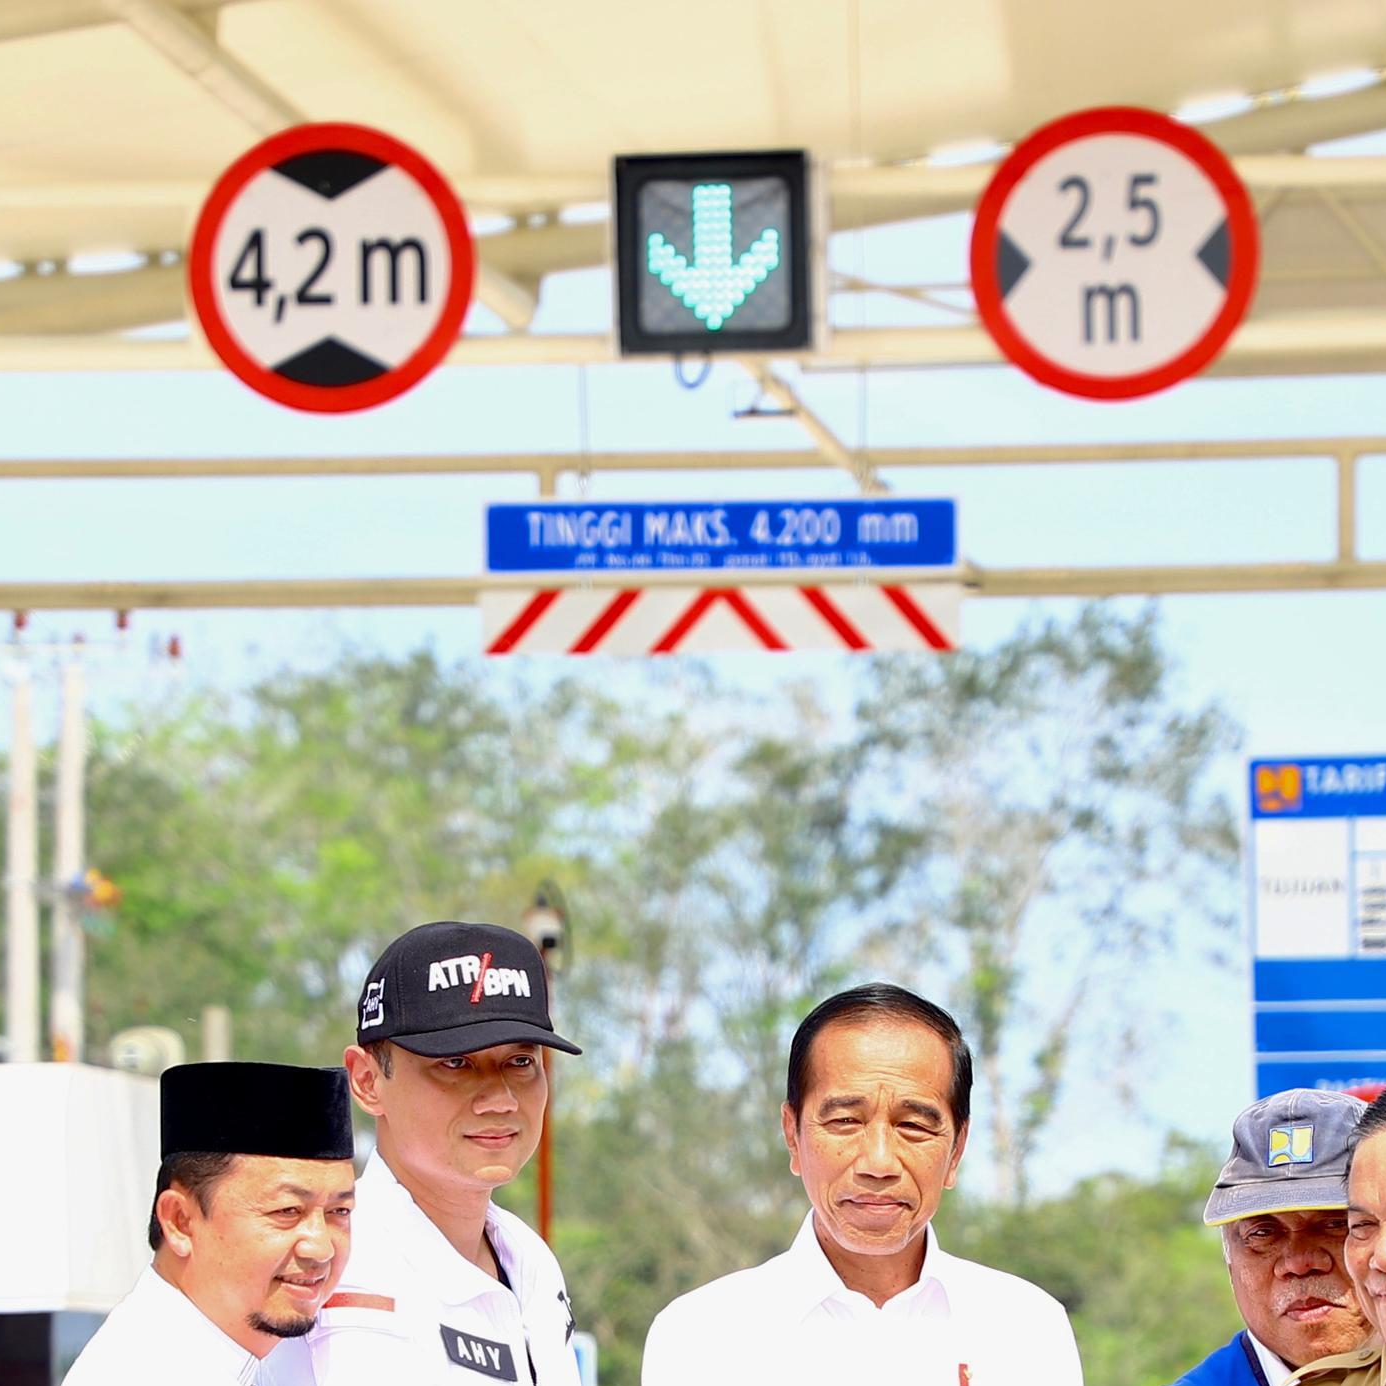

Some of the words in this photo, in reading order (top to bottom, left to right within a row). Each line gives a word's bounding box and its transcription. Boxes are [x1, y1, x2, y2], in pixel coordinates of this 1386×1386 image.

[1058, 174, 1161, 262] 2,5
[228, 227, 335, 323] 4,2
[360, 236, 429, 306] m
[1083, 283, 1141, 344] m
[527, 510, 633, 548] TINGGI
[643, 508, 739, 547] MAKS.
[749, 507, 843, 546] 4.200
[857, 511, 919, 543] mm
[428, 953, 531, 1003] ATR/BPN
[456, 1335, 501, 1371] AHY
